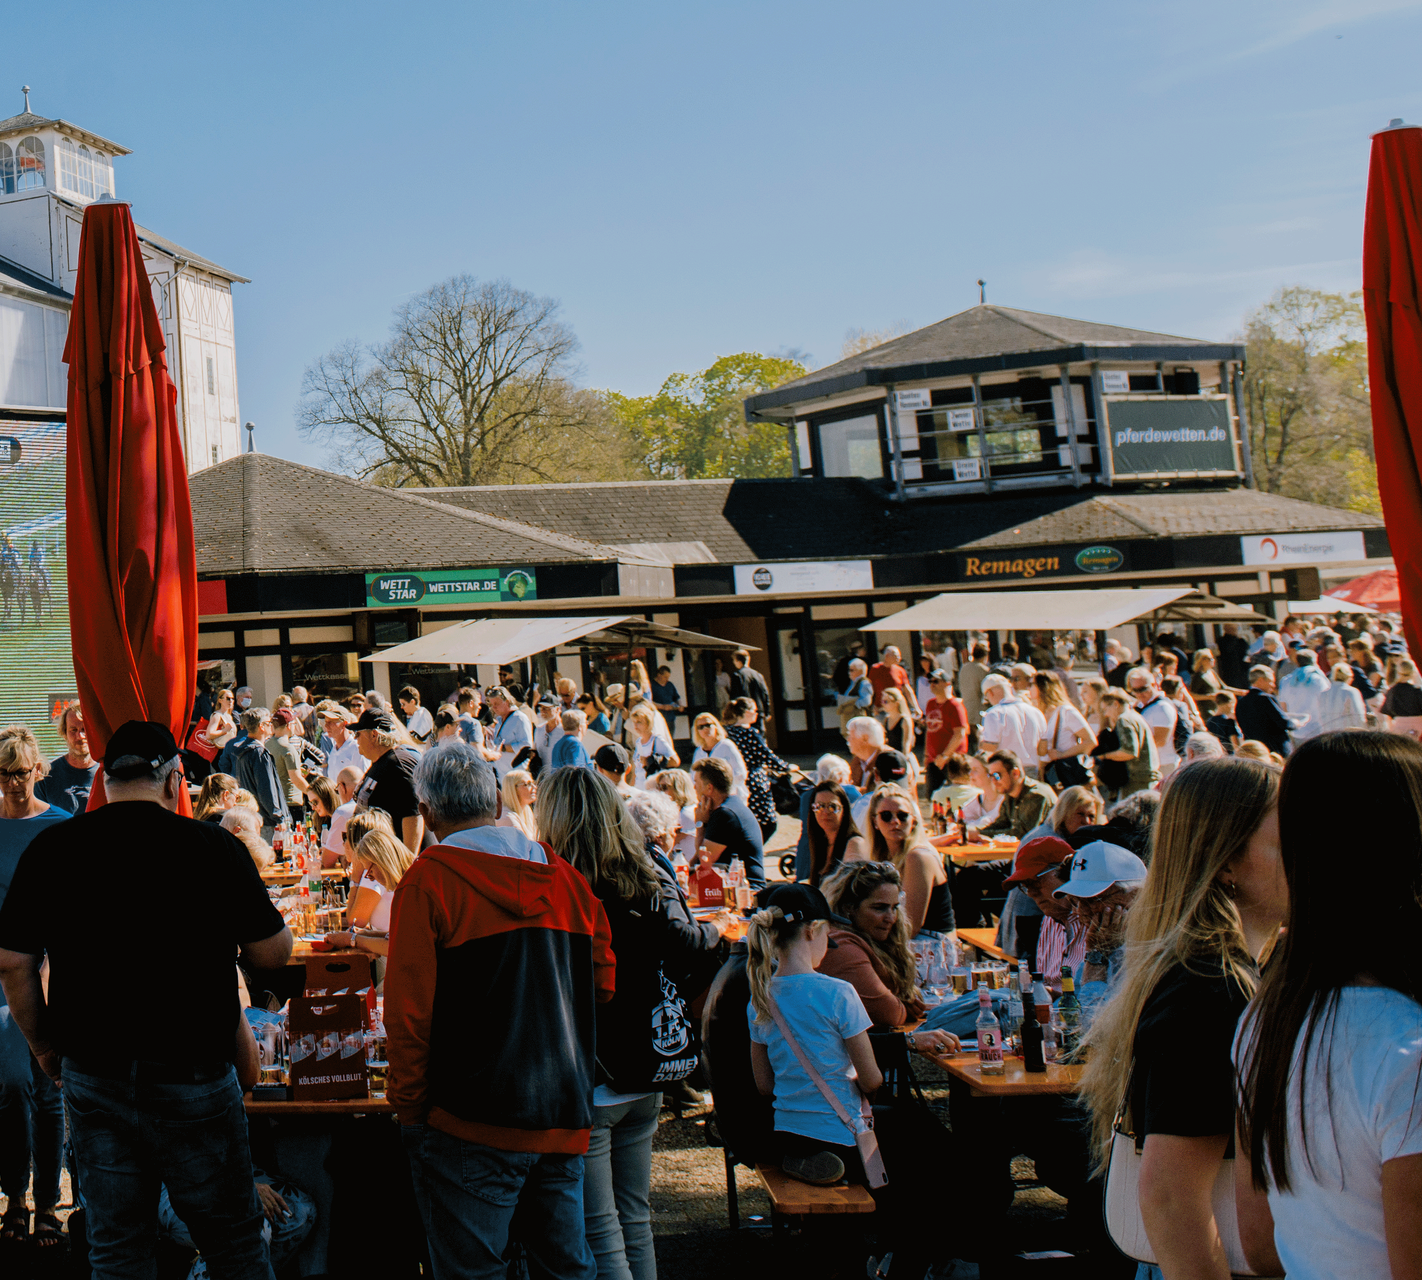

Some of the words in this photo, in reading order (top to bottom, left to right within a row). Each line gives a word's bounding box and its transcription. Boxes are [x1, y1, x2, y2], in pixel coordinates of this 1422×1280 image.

[1115, 426, 1226, 447] pferdewetten.de
[965, 556, 1060, 578] Remagen
[380, 579, 410, 590] WETT
[389, 590, 416, 600] STAR
[704, 888, 722, 897] früh
[298, 1076, 330, 1086] KÖLSCHES
[331, 1073, 364, 1083] VOLLBLUT.
